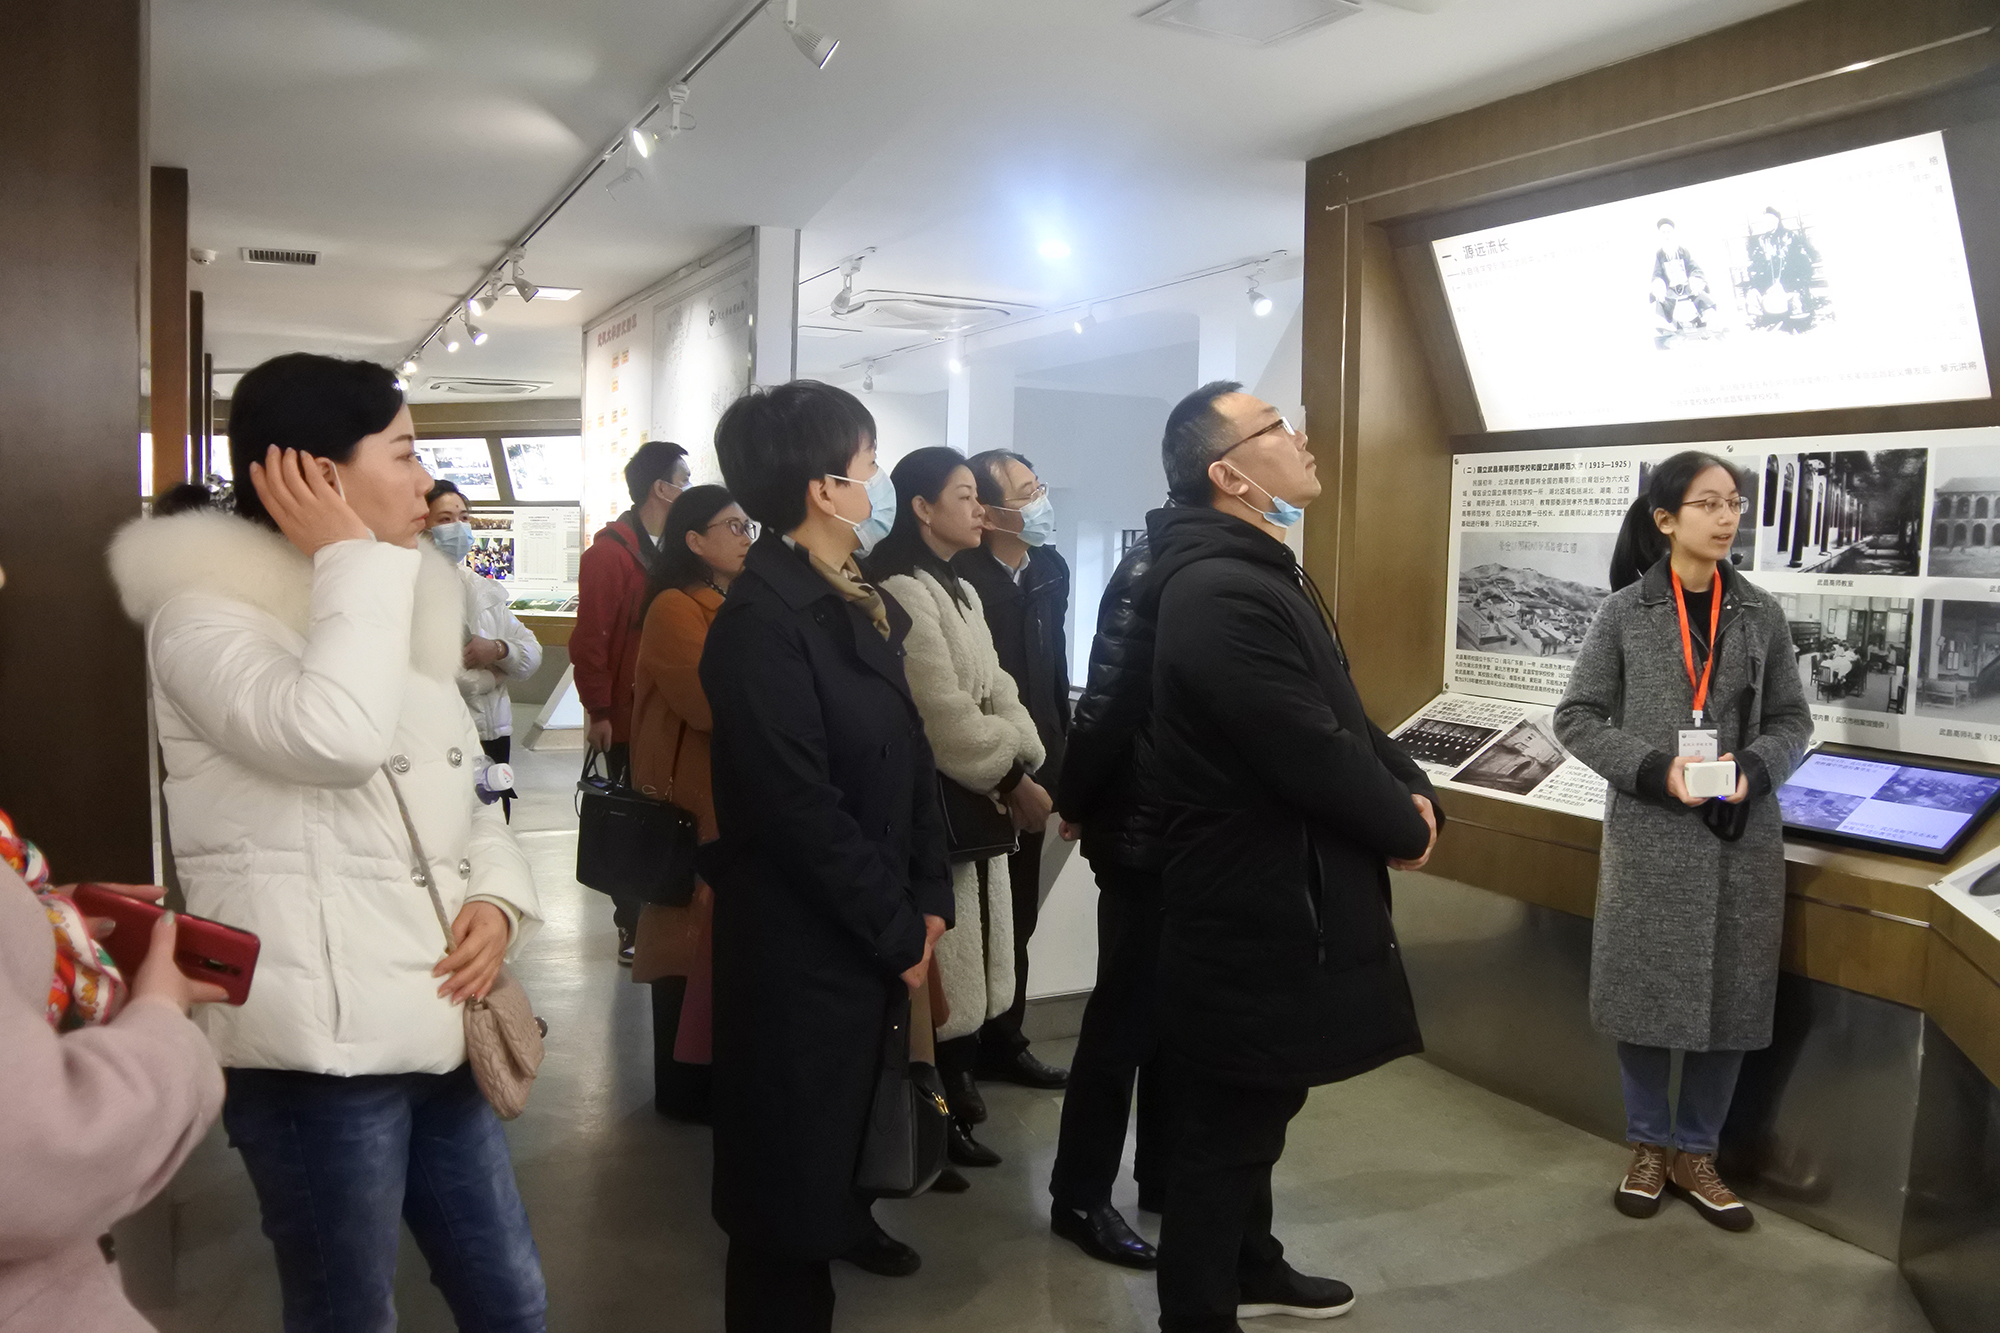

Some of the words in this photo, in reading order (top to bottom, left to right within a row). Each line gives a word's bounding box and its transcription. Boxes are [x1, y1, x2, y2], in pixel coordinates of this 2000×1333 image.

[1817, 579, 1854, 588] 武昌高师教室
